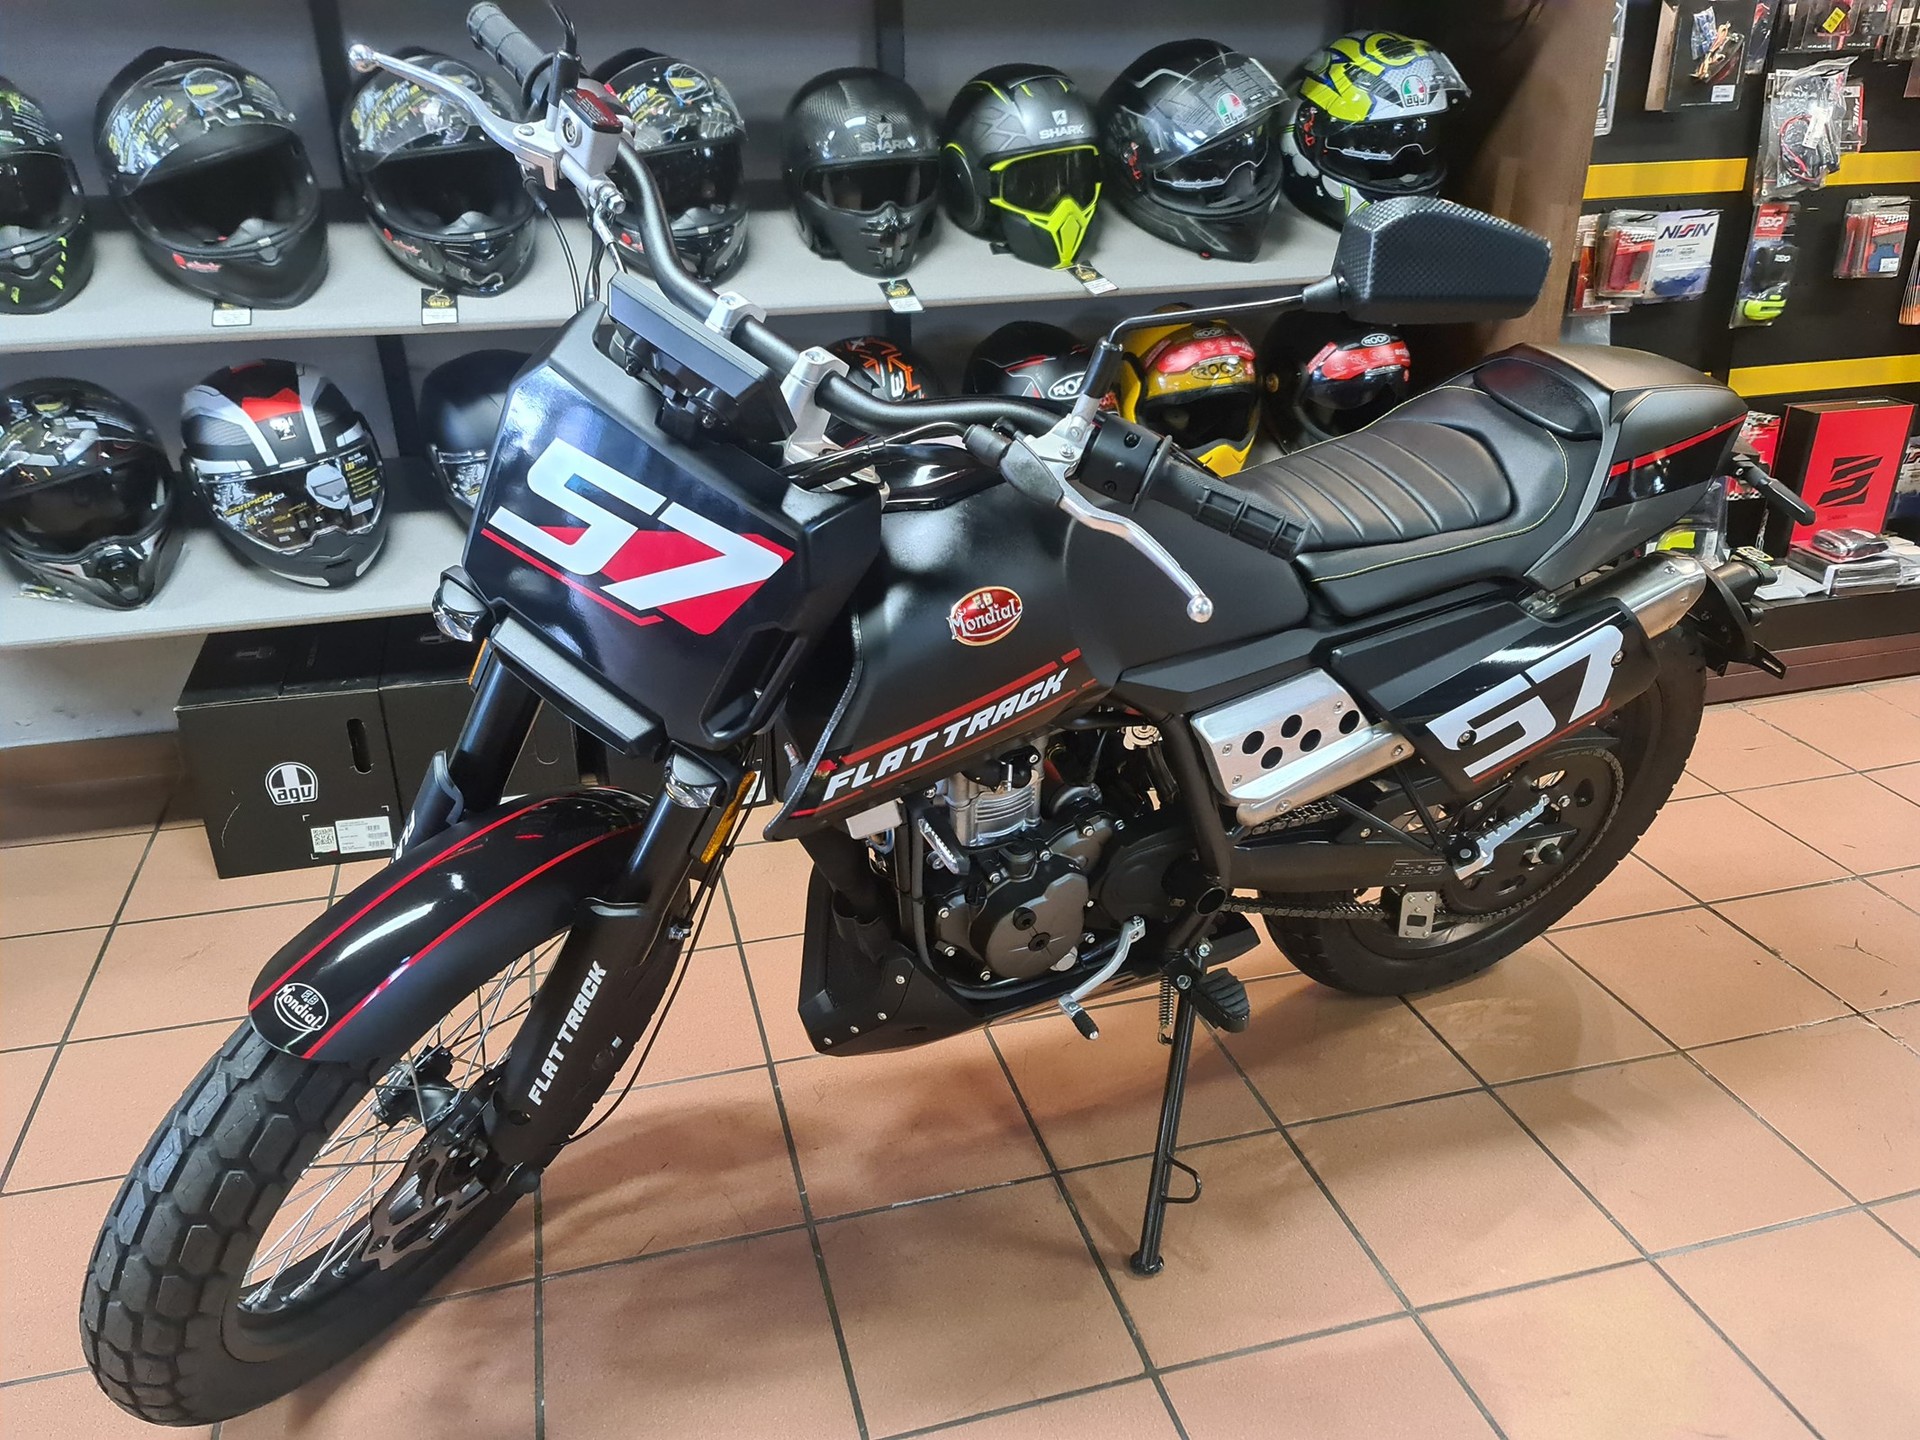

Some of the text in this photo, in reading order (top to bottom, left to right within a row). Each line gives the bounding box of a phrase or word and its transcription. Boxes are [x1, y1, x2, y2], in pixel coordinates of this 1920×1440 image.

[861, 138, 912, 152] SHARK
[1039, 124, 1084, 139] SHARK
[946, 598, 1020, 640] Mondial
[823, 667, 1069, 801] FLAT TRACK
[277, 786, 312, 803] agv
[276, 984, 323, 1029] Mondial
[528, 960, 607, 1106] FLAT TRACK
